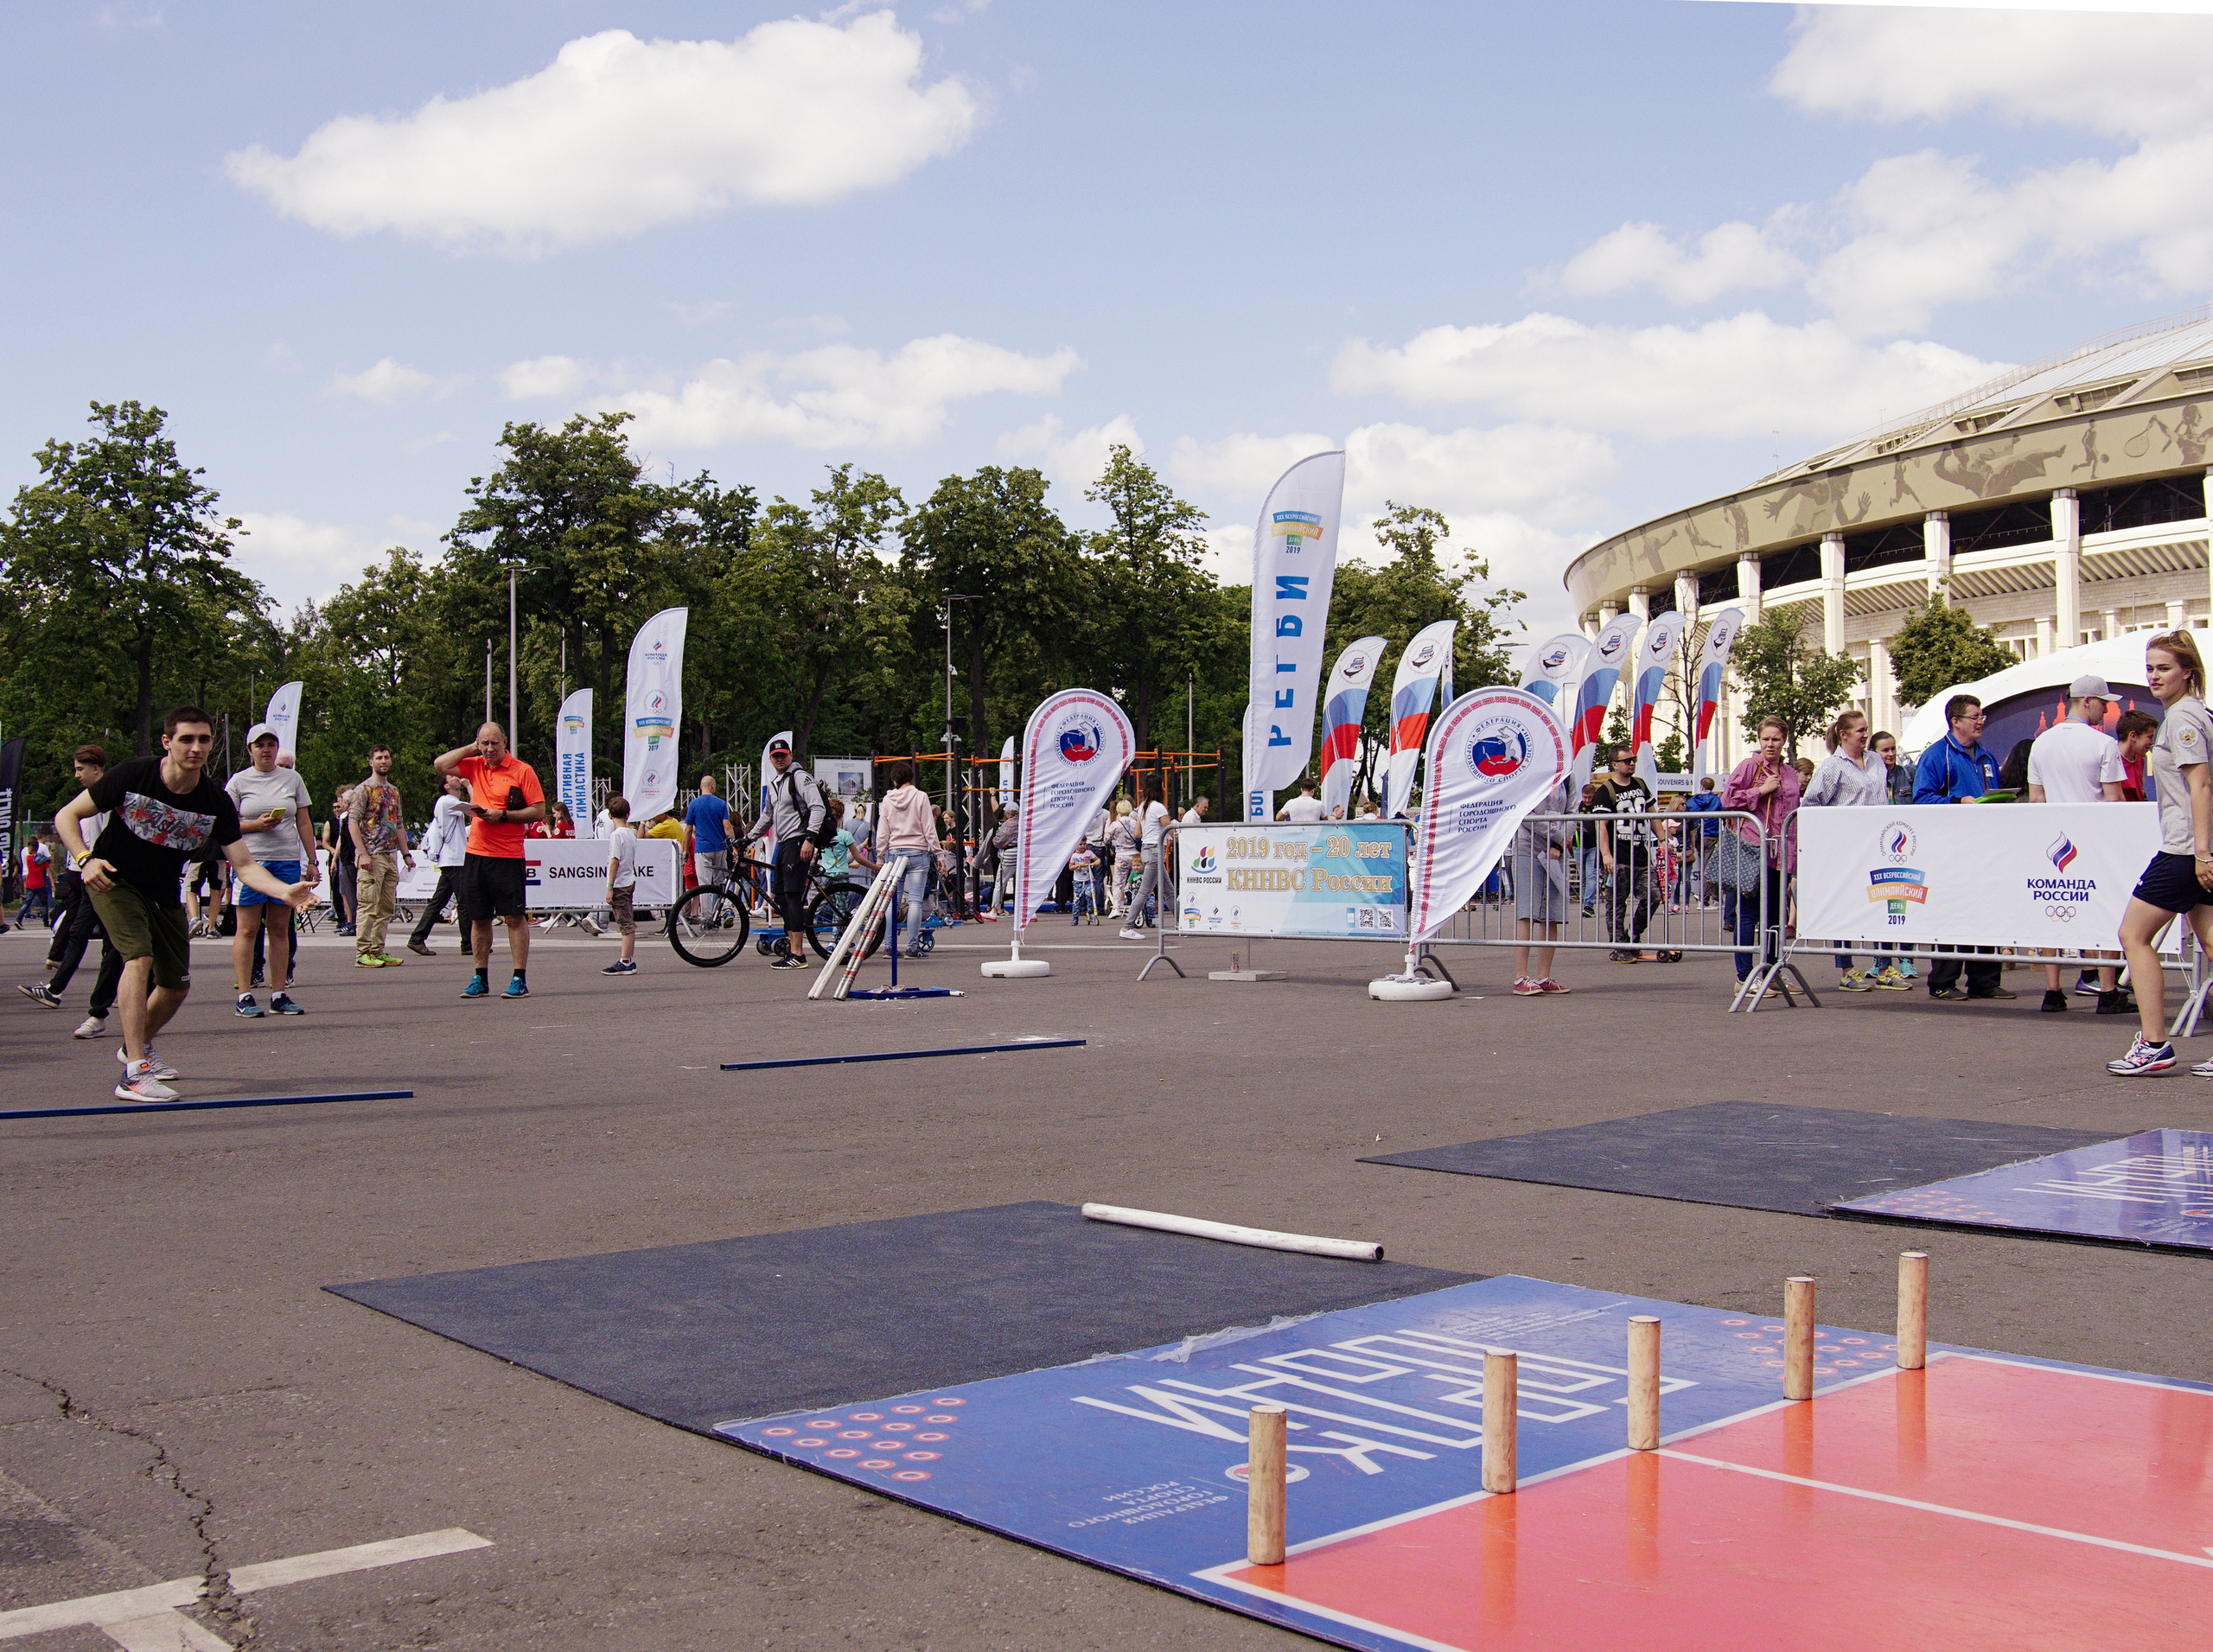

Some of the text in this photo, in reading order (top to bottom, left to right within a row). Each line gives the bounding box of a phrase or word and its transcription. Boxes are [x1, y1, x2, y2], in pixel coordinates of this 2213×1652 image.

[1273, 524, 1319, 536] ОЛИМПИЙСКИЙ
[1267, 576, 1309, 747] РЕГБИ
[1475, 718, 1521, 733] ФЕДЕРАЦИЯ
[1467, 740, 1496, 782] ГОРОДОШНОГО
[1498, 764, 1527, 782] СПОРТА
[575, 752, 587, 819] ГИМНАСТИКА
[1051, 787, 1095, 795] ГОРОДОШНОГО
[1459, 804, 1516, 818] ГОРОДОШНОГО
[1460, 800, 1503, 809] ФЕДЕРАЦИЯ
[1458, 817, 1488, 826] СПОРТА
[1458, 824, 1488, 833] РОССИИ
[1879, 821, 1896, 857] ОЛИМПИЙСКИЙ
[1896, 820, 1915, 835] КОМИТЕТ
[1226, 836, 1270, 859] 2019
[1273, 840, 1308, 862] год
[1326, 835, 1350, 858] 20
[1354, 840, 1392, 858] лет
[549, 866, 608, 878] SANGSIN
[1883, 871, 1922, 881] ВСЕРОССИЙСКИЙ
[1226, 867, 1392, 893] КННВС России
[2027, 878, 2096, 890] КОМАНДА
[1871, 884, 1923, 900] ОЛИМПИЙСКИЙ
[2033, 890, 2089, 902] РОССИИ
[1888, 915, 1906, 925] 2019
[1102, 1480, 1181, 1502] РОССИИ
[1120, 1485, 1196, 1506] СПОРТА
[1068, 1489, 1215, 1528] ГОРОДОШНОГО
[1121, 1494, 1229, 1526] ФЕДЕРАЦИЯ
